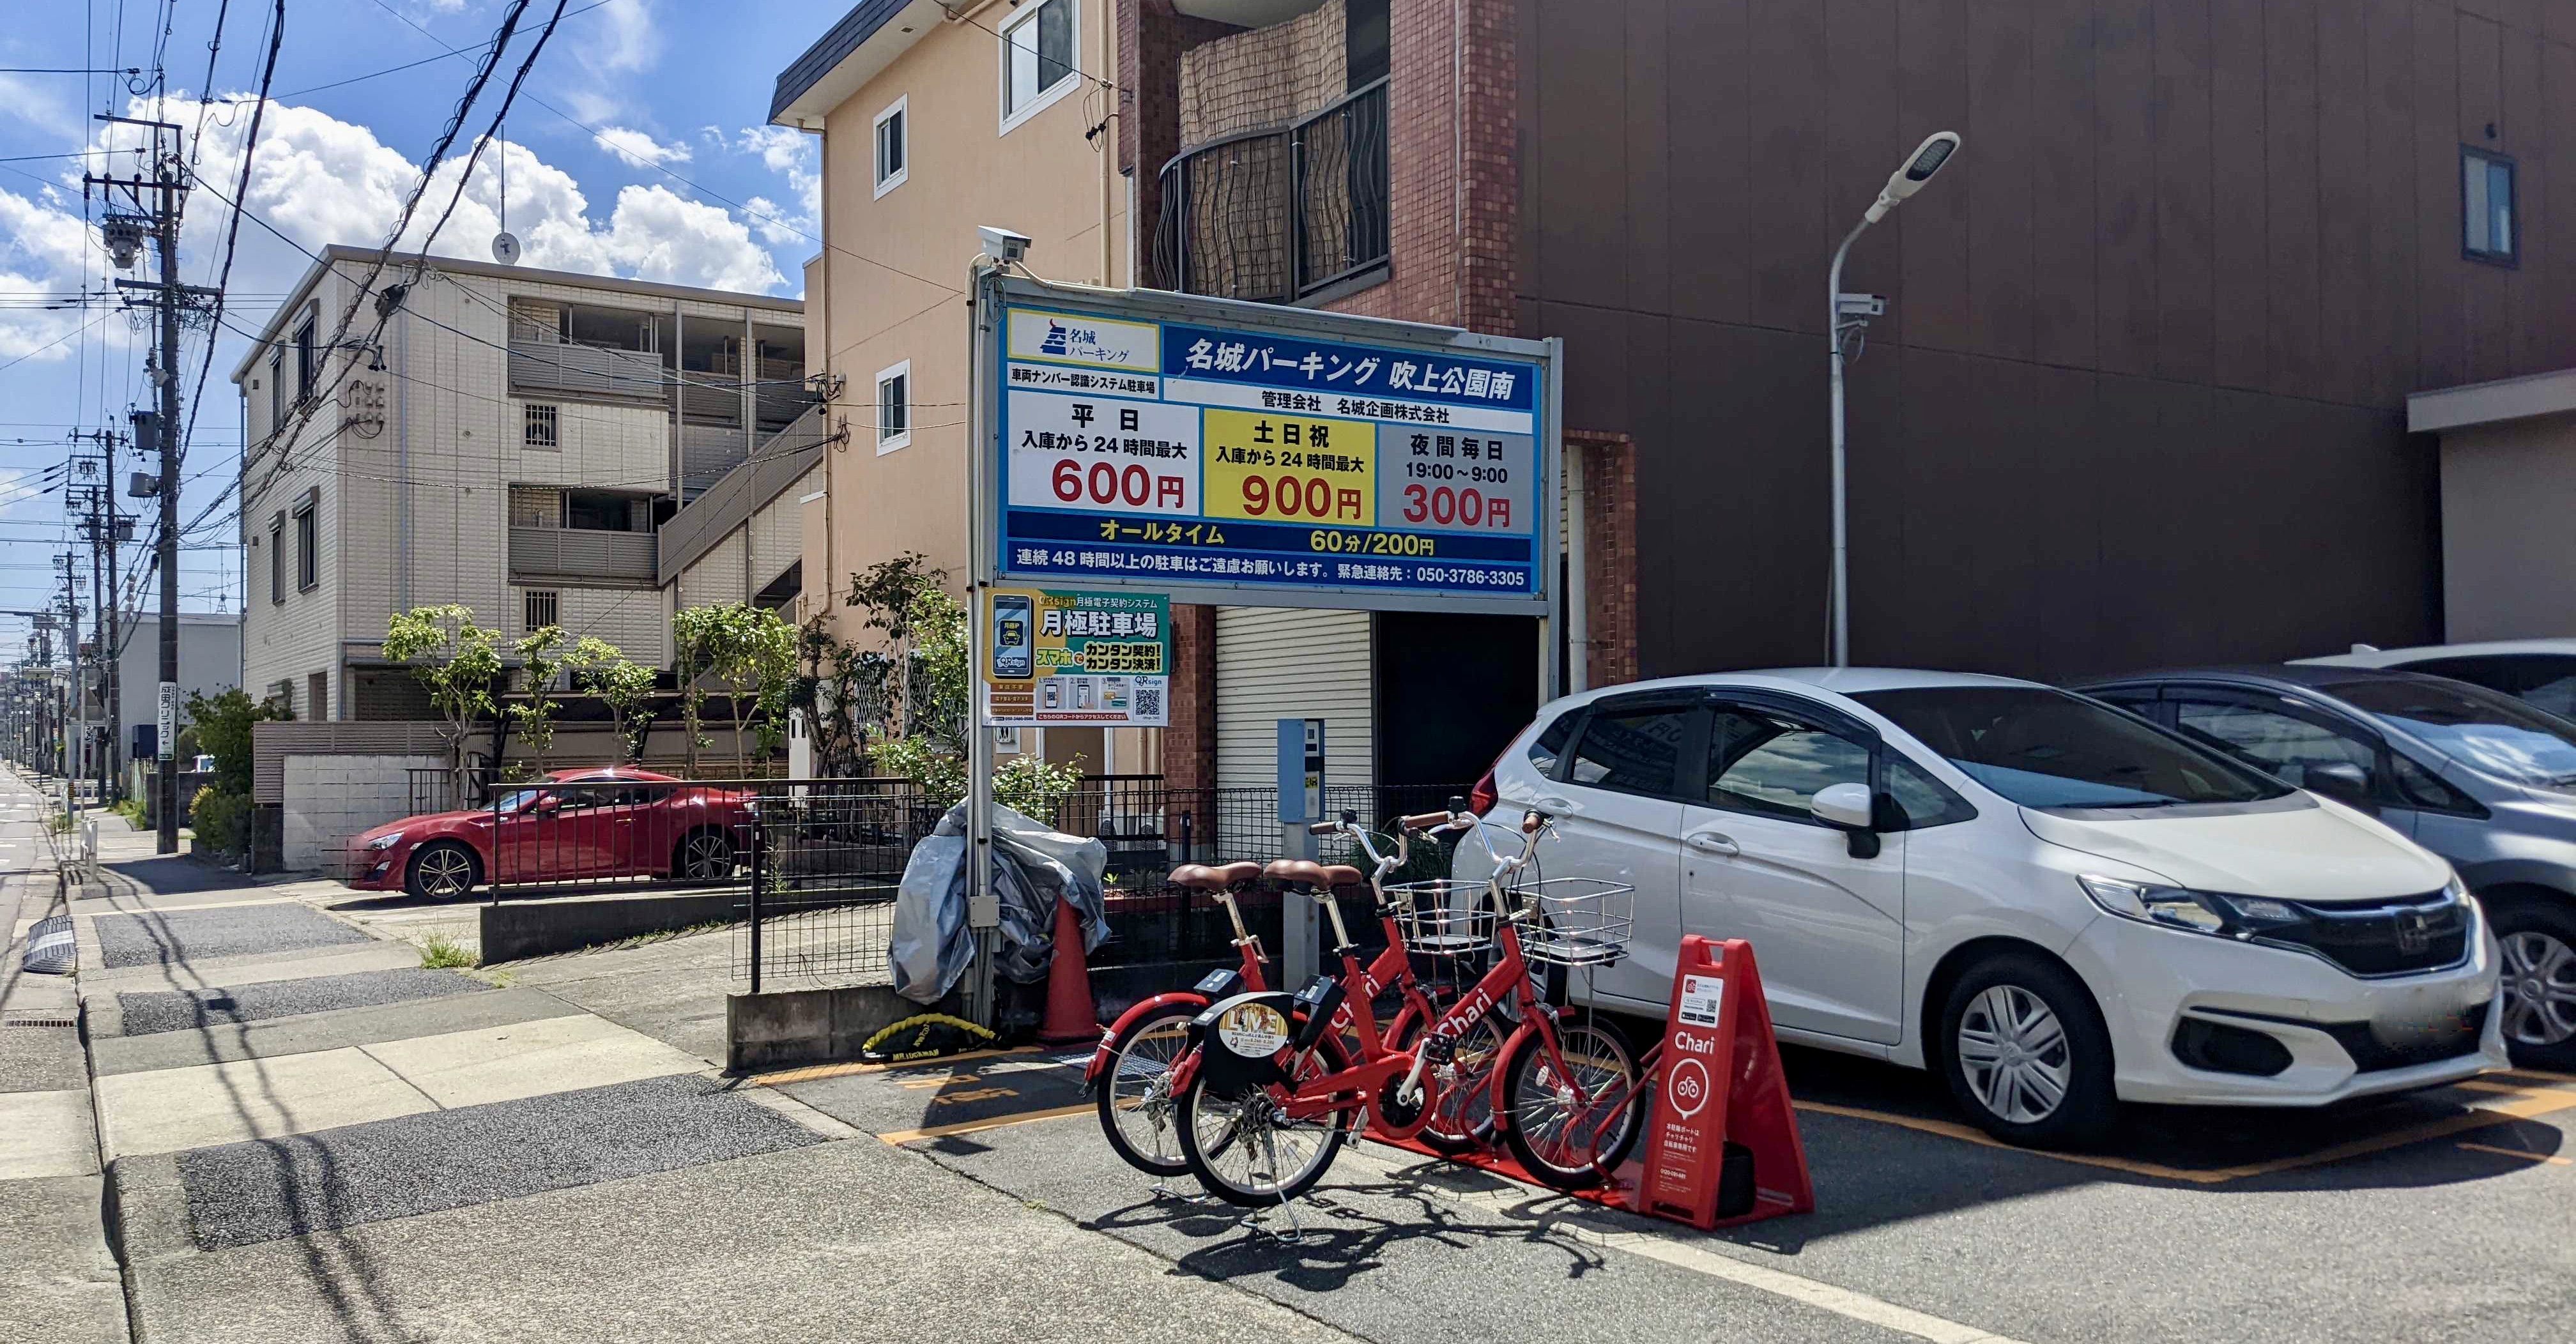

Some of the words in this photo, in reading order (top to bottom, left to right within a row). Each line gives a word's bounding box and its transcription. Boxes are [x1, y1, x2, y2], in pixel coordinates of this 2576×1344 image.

[1070, 328, 1096, 345] 名城
[1070, 346, 1129, 363] パーキング
[1011, 367, 1156, 394] 車両ナンバー認識システム駐車場
[1186, 338, 1380, 386] 名城パーキング
[1388, 360, 1516, 401] 吹上公園南
[1071, 403, 1139, 431] 平日
[1261, 390, 1321, 412] 管理会社
[1336, 398, 1450, 424] 名城企画株式会社
[1254, 420, 1329, 448] 土日祝
[1409, 433, 1503, 461] 夜間毎日
[1052, 459, 1184, 508] 600円
[1242, 475, 1361, 520] 900円
[1403, 484, 1510, 528] 300円
[1100, 519, 1225, 545] オールタイム
[1310, 530, 1434, 556] 60分/200円
[1416, 567, 1524, 586] 050-3786-3305
[1077, 597, 1157, 608] 月極電子契約システム
[1040, 609, 1158, 638] 月極駐車場
[1135, 676, 1162, 687] QRsign
[1331, 974, 1381, 1029] Chri
[1675, 1031, 1715, 1055] Chari
